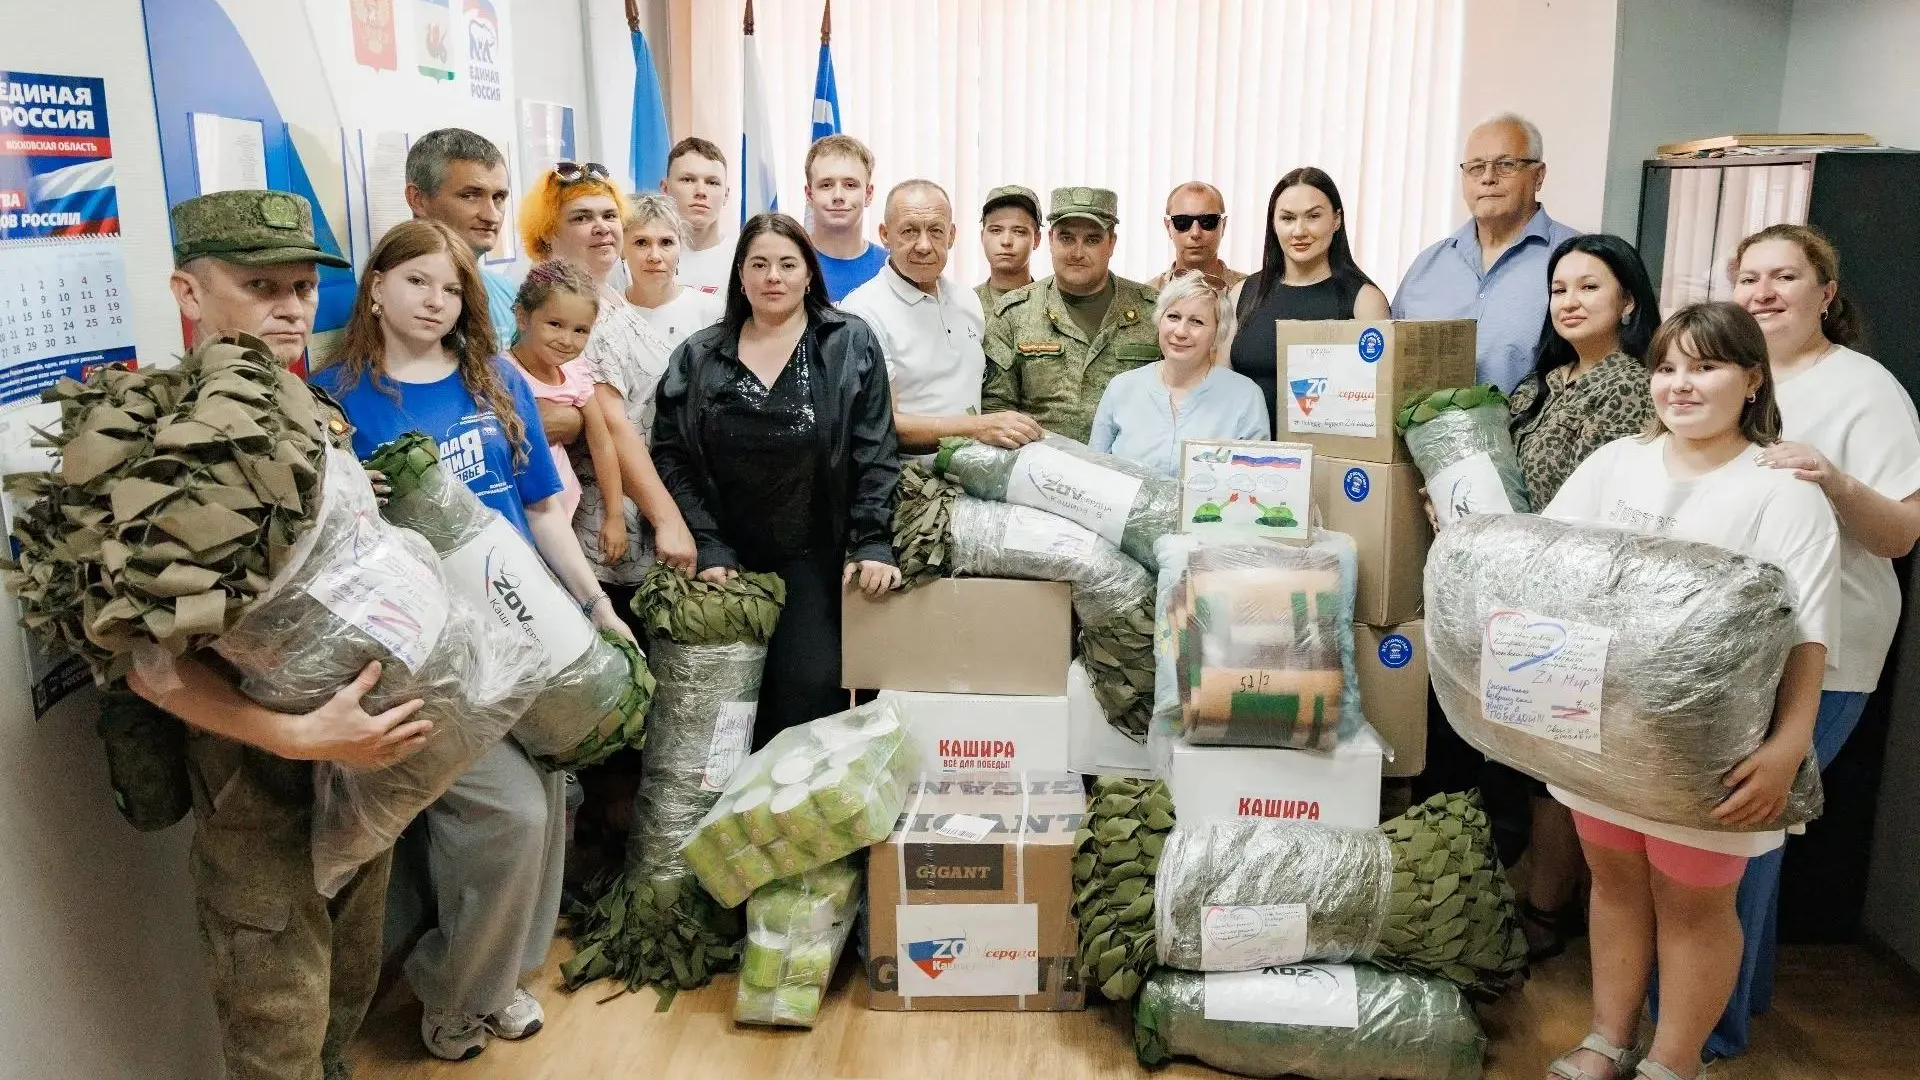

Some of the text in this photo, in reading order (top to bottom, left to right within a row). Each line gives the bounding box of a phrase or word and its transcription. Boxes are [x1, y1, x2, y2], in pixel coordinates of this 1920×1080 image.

[469, 66, 500, 84] ЕДИНАЯ
[0, 81, 92, 105] ЕДИНАЯ
[471, 84, 501, 101] РОССИЯ
[0, 106, 95, 129] РОССИЯ
[58, 142, 97, 151] ОБЛАСТЬ
[21, 212, 80, 227] РОССИИ
[59, 279, 64, 287] 3
[105, 275, 112, 283] 5
[59, 293, 69, 301] 10
[81, 291, 93, 299] 11
[105, 288, 118, 297] 12
[41, 309, 51, 318] 16
[61, 307, 71, 316] 17
[83, 304, 96, 313] 18
[108, 302, 119, 310] 19
[44, 324, 53, 333] 23
[64, 321, 74, 330] 24
[86, 318, 98, 327] 25
[110, 316, 122, 324] 26
[45, 338, 55, 347] 30
[65, 336, 76, 344] 31
[492, 575, 534, 622] ZOV
[940, 739, 1015, 757] КАШИРА
[959, 760, 975, 769] ДЛЯ
[976, 761, 1010, 769] ПОБЕДЫ!
[1238, 798, 1320, 819] КАШИРА
[916, 866, 990, 879] GIGANT
